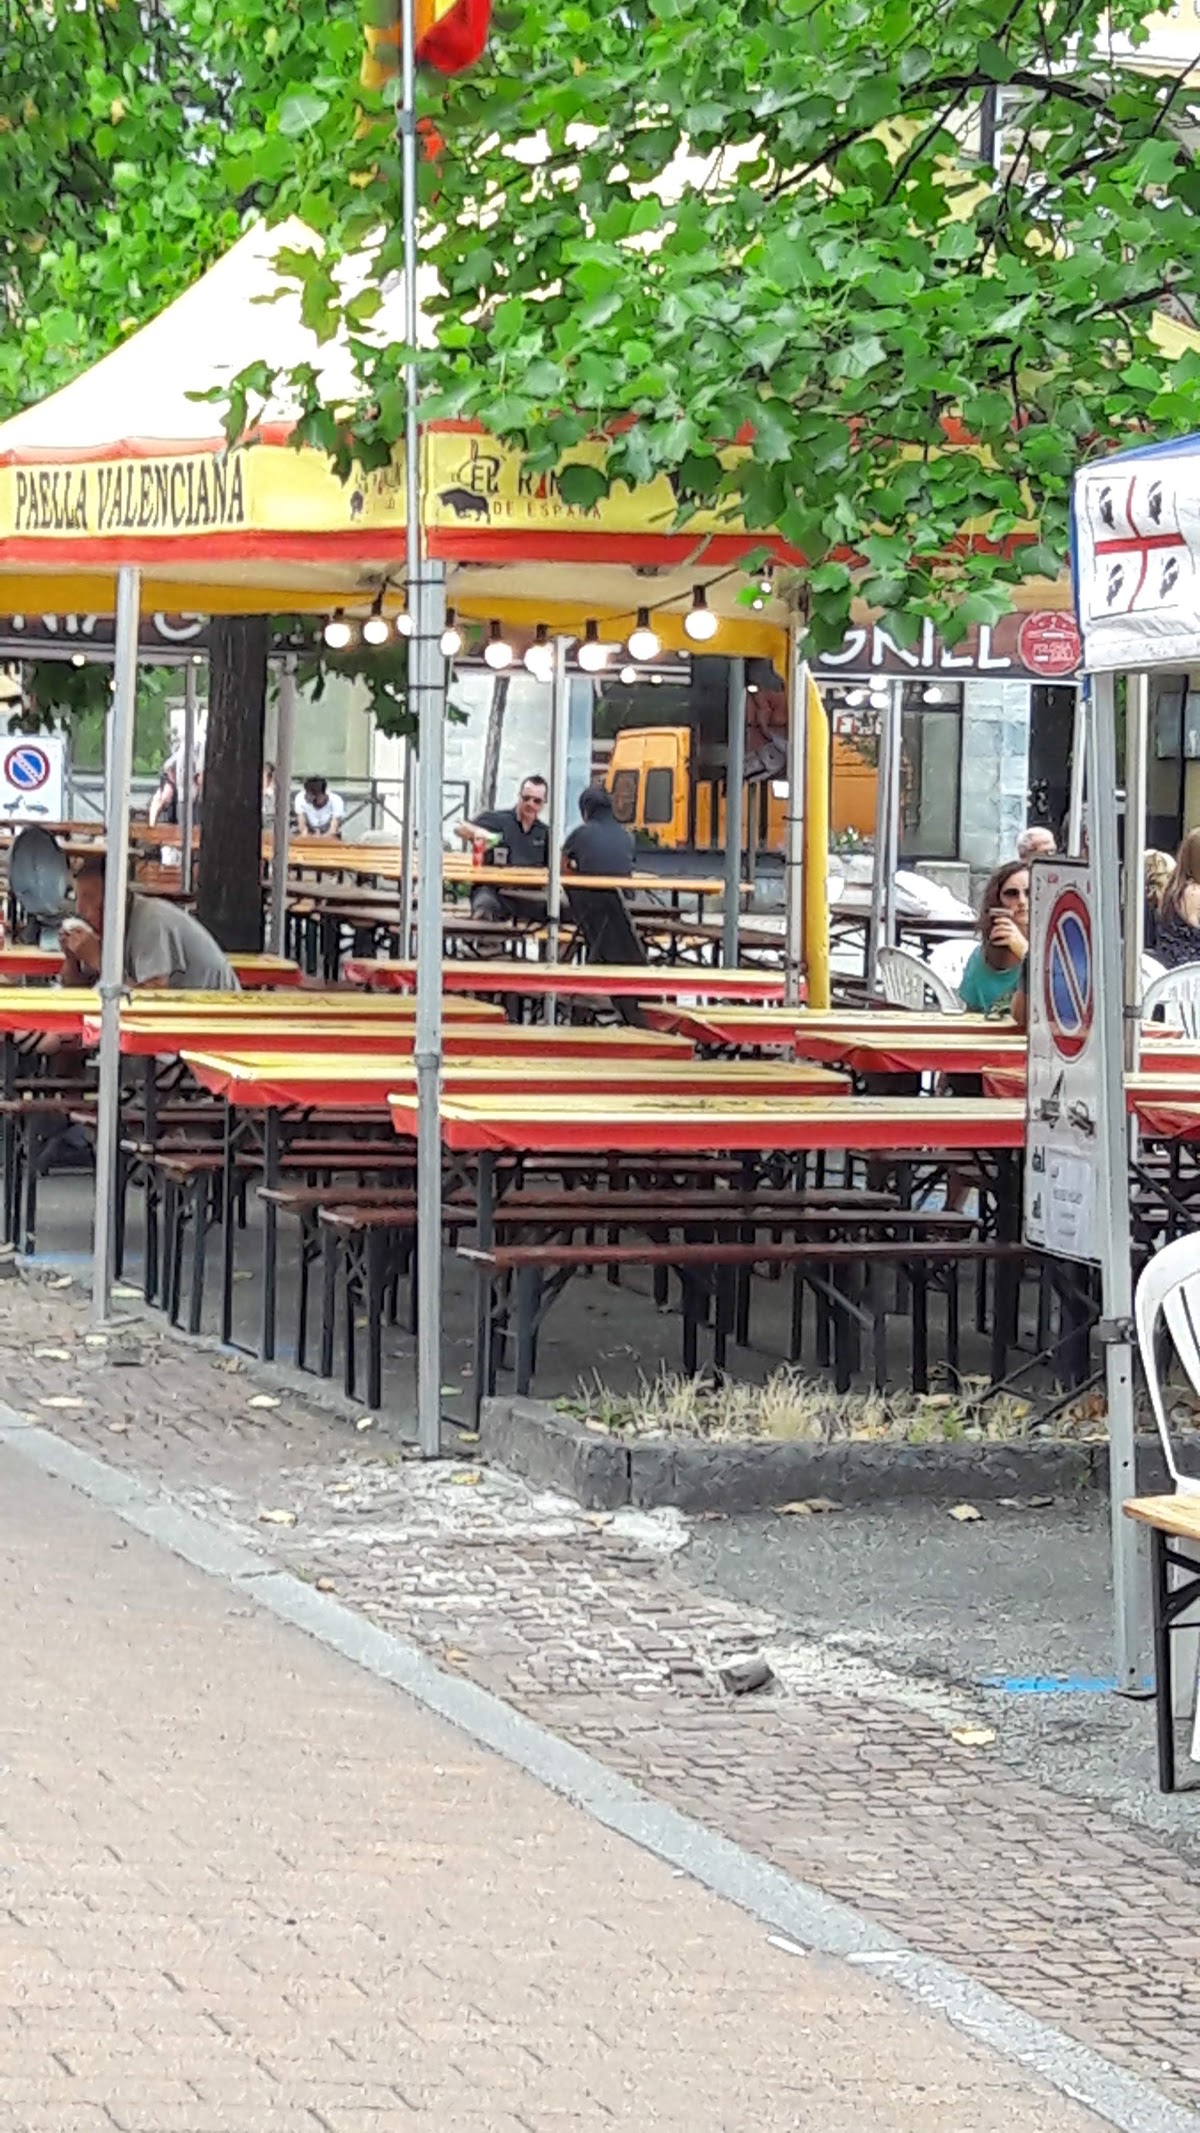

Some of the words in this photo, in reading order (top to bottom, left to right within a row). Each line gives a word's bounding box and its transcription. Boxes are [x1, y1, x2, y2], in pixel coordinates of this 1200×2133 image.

[15, 470, 88, 530] PAELLA
[97, 455, 244, 530] VALENCIANA
[493, 500, 514, 515] DE
